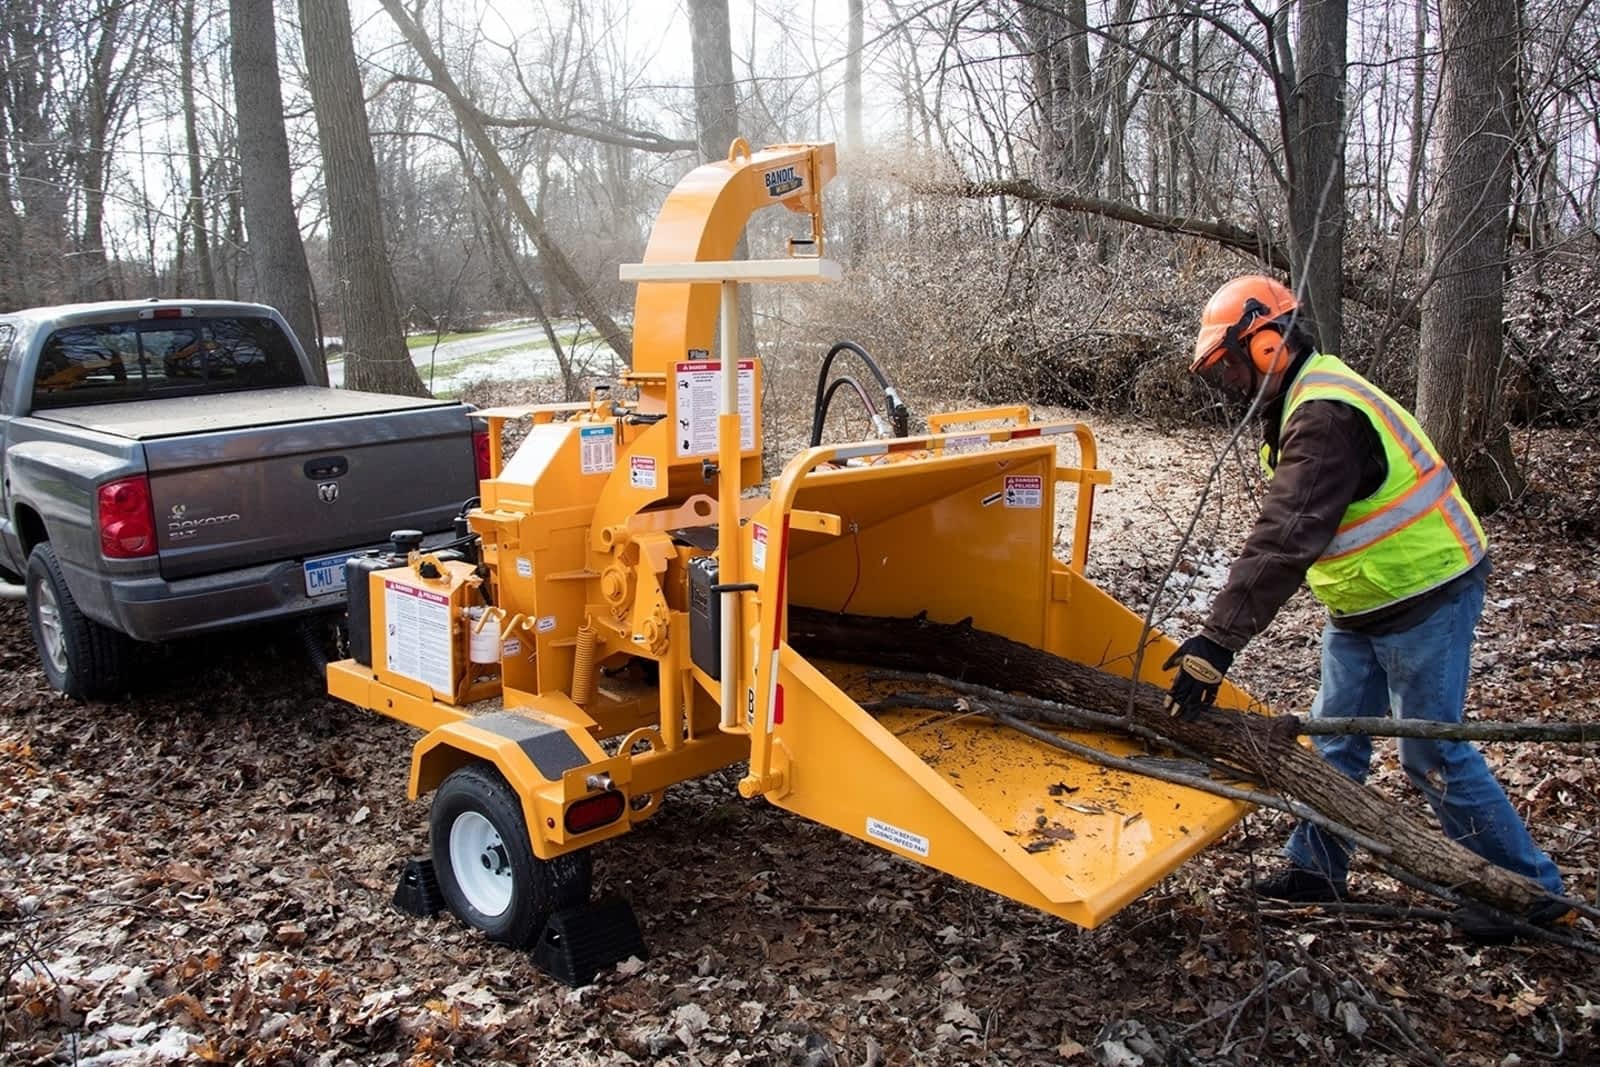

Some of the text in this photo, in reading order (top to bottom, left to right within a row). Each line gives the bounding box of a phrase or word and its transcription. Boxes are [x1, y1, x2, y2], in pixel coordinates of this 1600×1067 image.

[765, 167, 794, 187] BANDIT
[168, 514, 240, 529] DAKOTA
[309, 568, 332, 588] CMU
[395, 583, 414, 593] DANGER
[869, 827, 926, 853] CLOSING INFEED PAN
[873, 822, 921, 844] UNLATCH BEFORE
